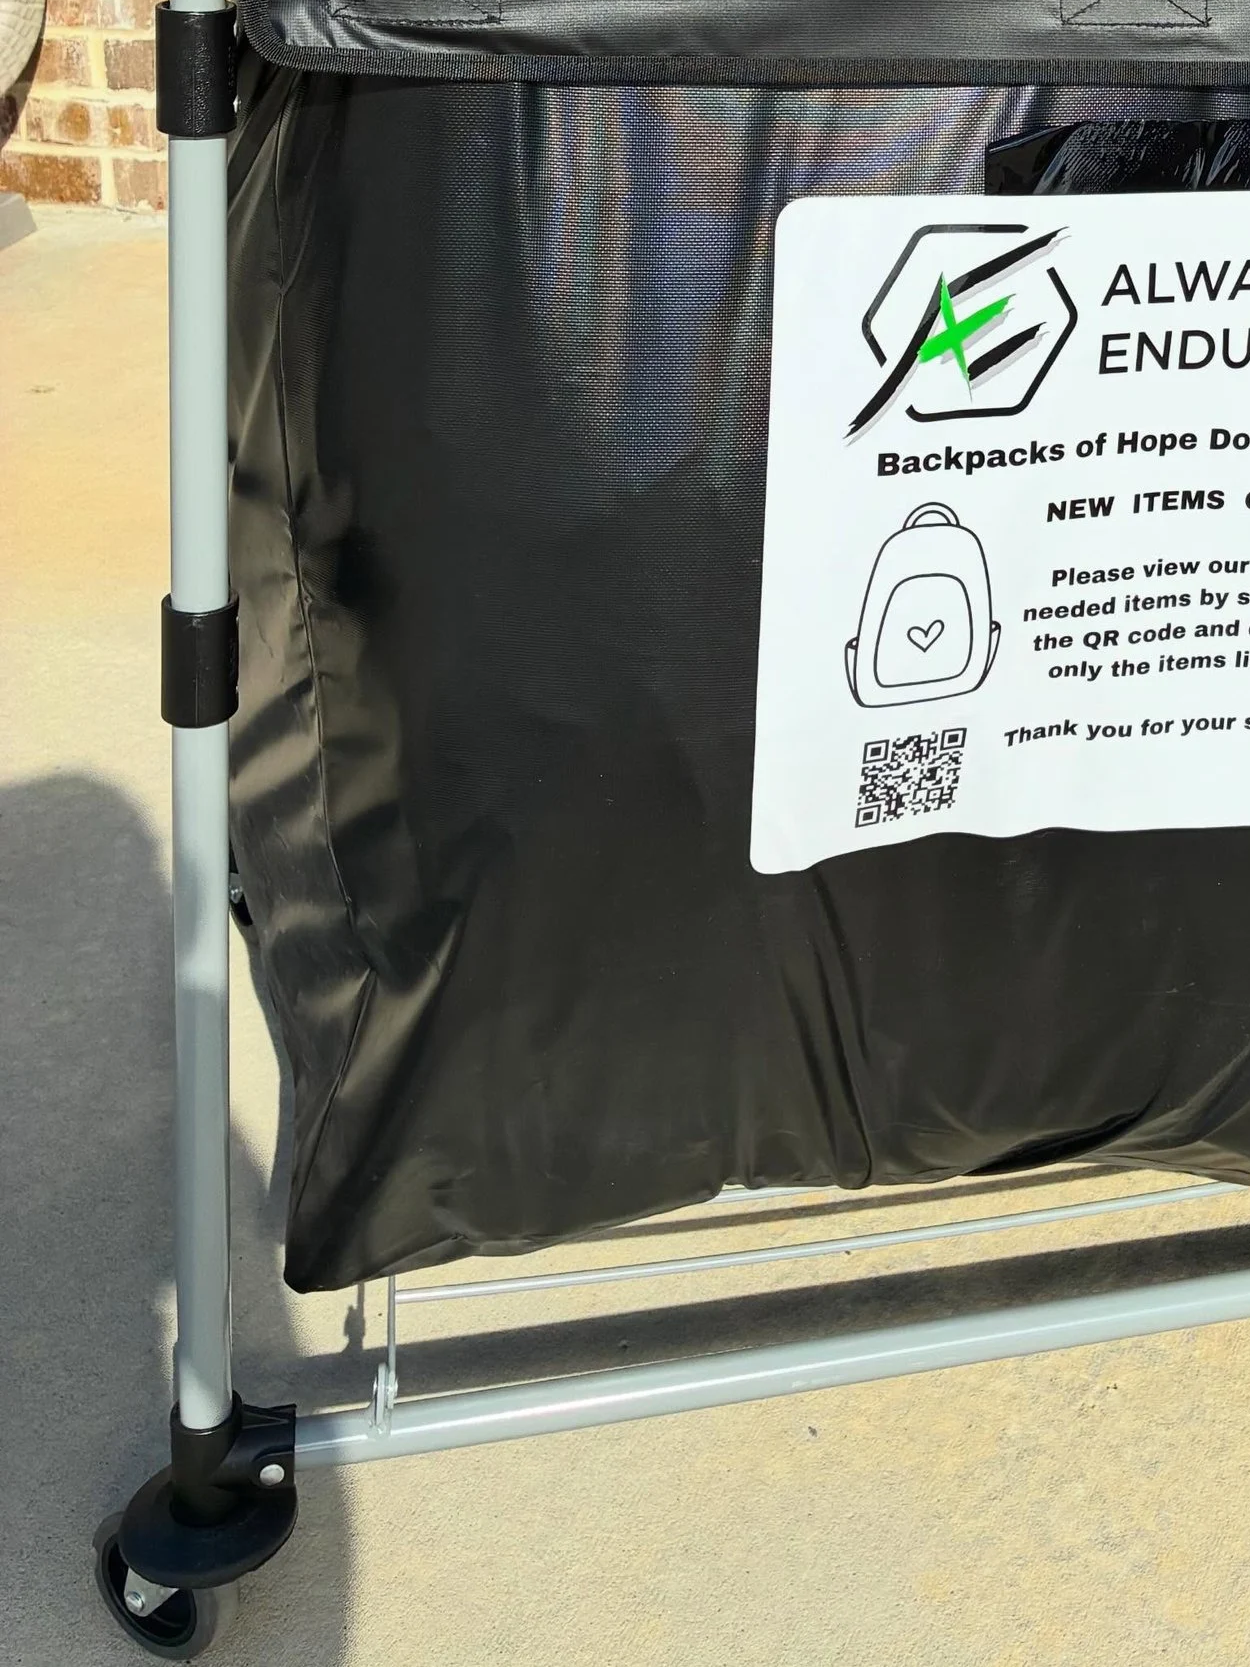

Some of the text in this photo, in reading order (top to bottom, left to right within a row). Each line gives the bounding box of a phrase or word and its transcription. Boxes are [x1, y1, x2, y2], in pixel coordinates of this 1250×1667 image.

[877, 440, 1065, 477] Backpacks
[1075, 432, 1108, 458] of
[1116, 430, 1198, 457] Hope
[1046, 495, 1115, 523] NEW
[1133, 489, 1225, 514] ITEMS
[1051, 566, 1135, 588] Please
[1142, 558, 1201, 578] view
[1208, 560, 1250, 574] our
[1023, 596, 1116, 622] needed
[1124, 593, 1192, 613] items
[1199, 588, 1230, 610] by
[1033, 633, 1074, 652] the
[1082, 629, 1120, 651] QR
[1127, 622, 1187, 645] code
[1194, 619, 1240, 638] and
[1048, 660, 1103, 682] only
[1110, 659, 1151, 678] the
[1158, 654, 1226, 673] items
[1003, 719, 1079, 747] Thank
[1085, 724, 1133, 741] you
[1140, 718, 1175, 736] for
[1180, 717, 1237, 737] your
